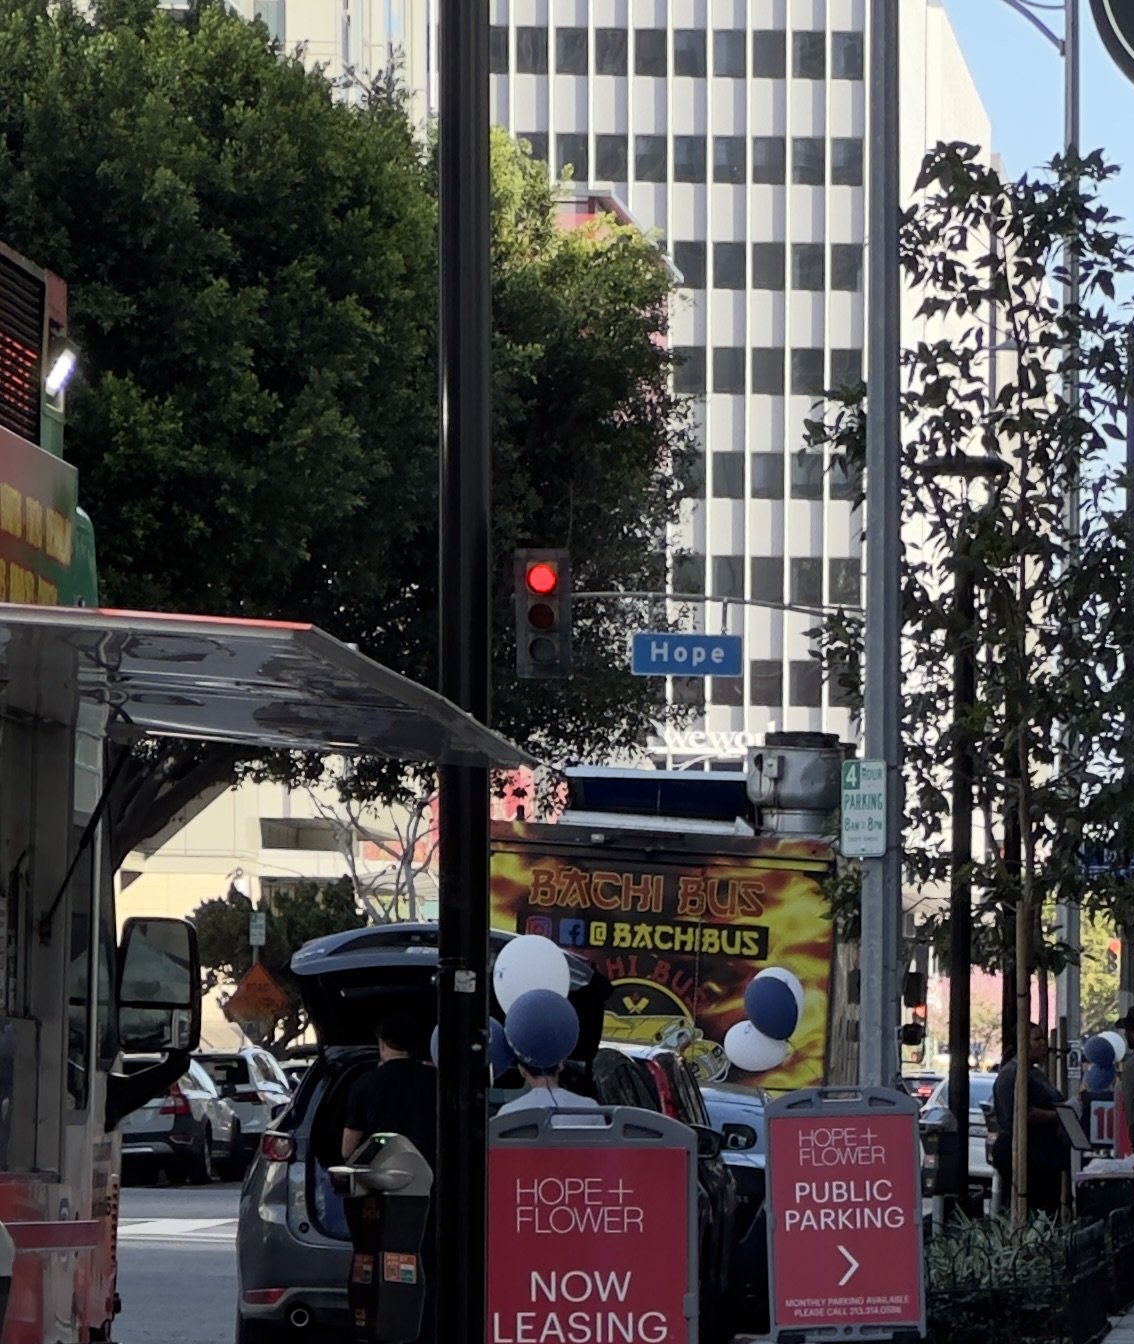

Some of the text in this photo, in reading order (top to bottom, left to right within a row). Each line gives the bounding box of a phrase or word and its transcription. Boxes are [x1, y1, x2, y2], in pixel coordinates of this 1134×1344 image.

[651, 641, 725, 666] Hope
[662, 721, 776, 748] wewor
[845, 764, 857, 787] 4
[844, 793, 882, 810] PARKING
[529, 867, 766, 918] BACHI BUS
[800, 1146, 886, 1166] FLOWER
[795, 1179, 893, 1204] PUBLIC
[516, 1206, 644, 1234] FLOWER
[785, 1206, 905, 1232] PARKING
[531, 1271, 632, 1302] NOW
[785, 1295, 910, 1308] MONTHLY PARKING AVAILABLE
[794, 1307, 825, 1317] PLEASE
[826, 1306, 847, 1316] CALL
[493, 1311, 668, 1344] LEASING
